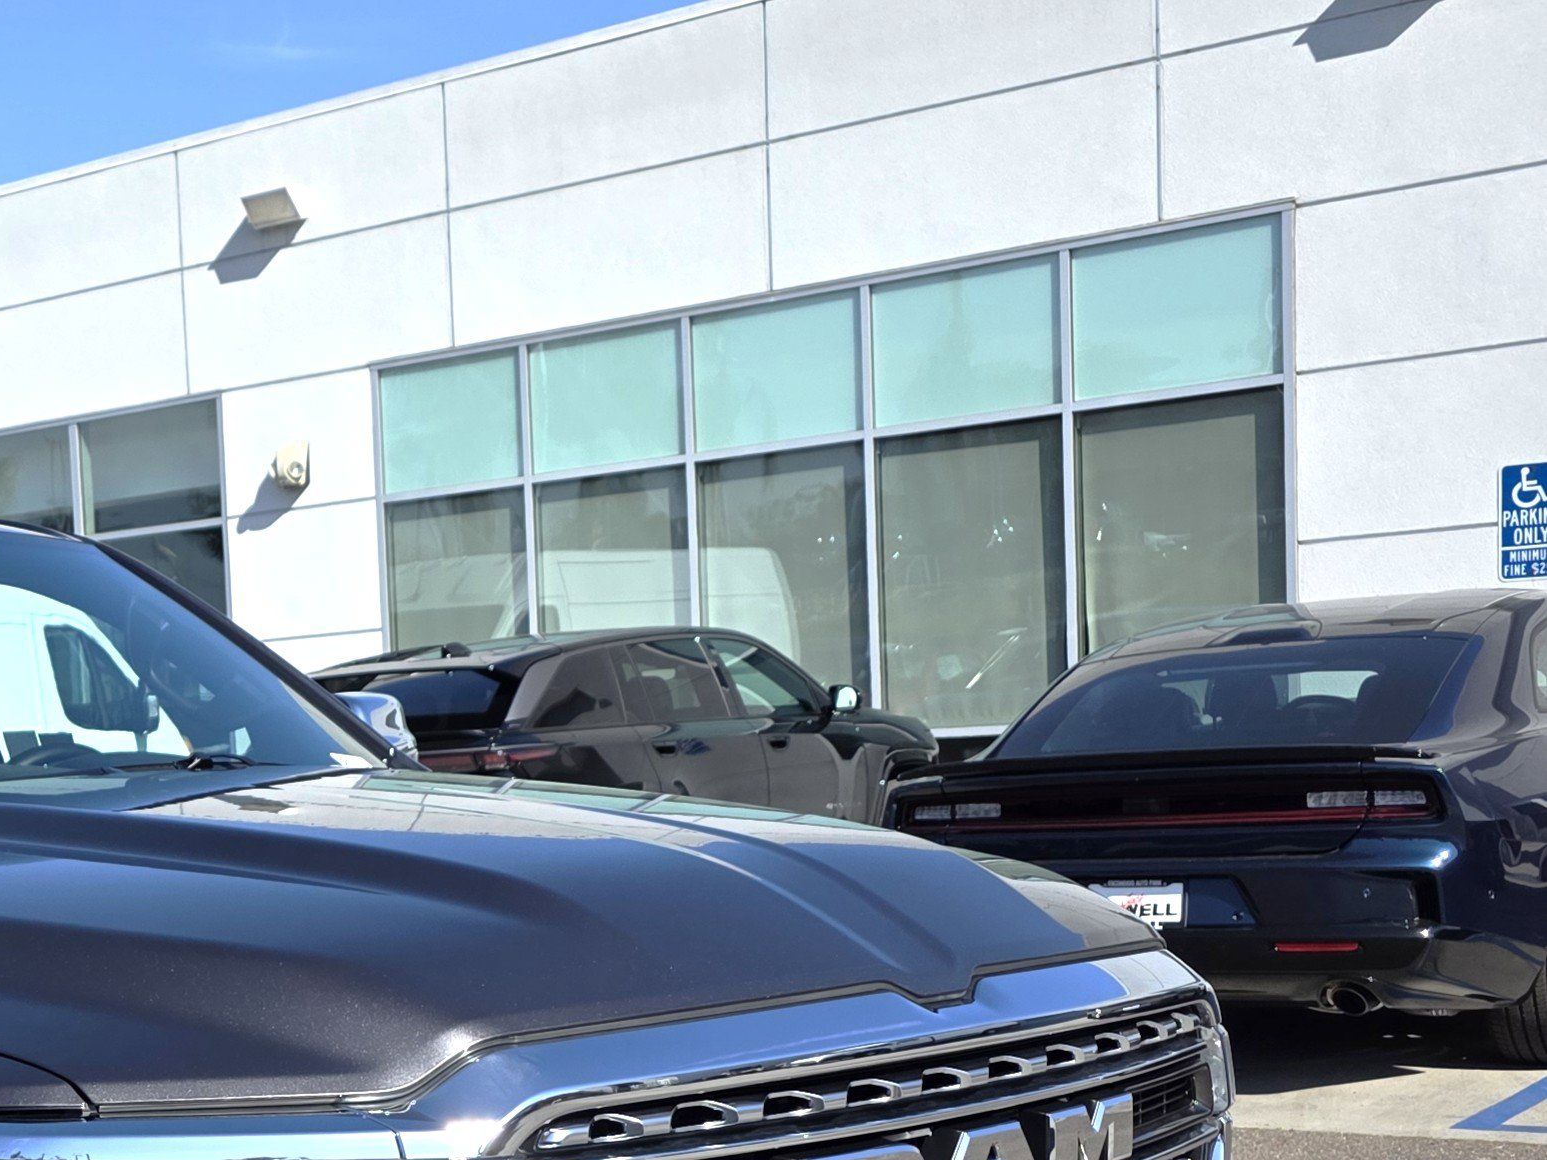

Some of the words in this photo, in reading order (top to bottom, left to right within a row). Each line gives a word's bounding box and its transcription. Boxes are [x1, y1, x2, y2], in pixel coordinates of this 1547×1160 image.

[1514, 526, 1547, 545] ONLY
[1509, 549, 1547, 563] MINIMU
[1504, 564, 1527, 577] FINE
[1532, 561, 1547, 576] $2
